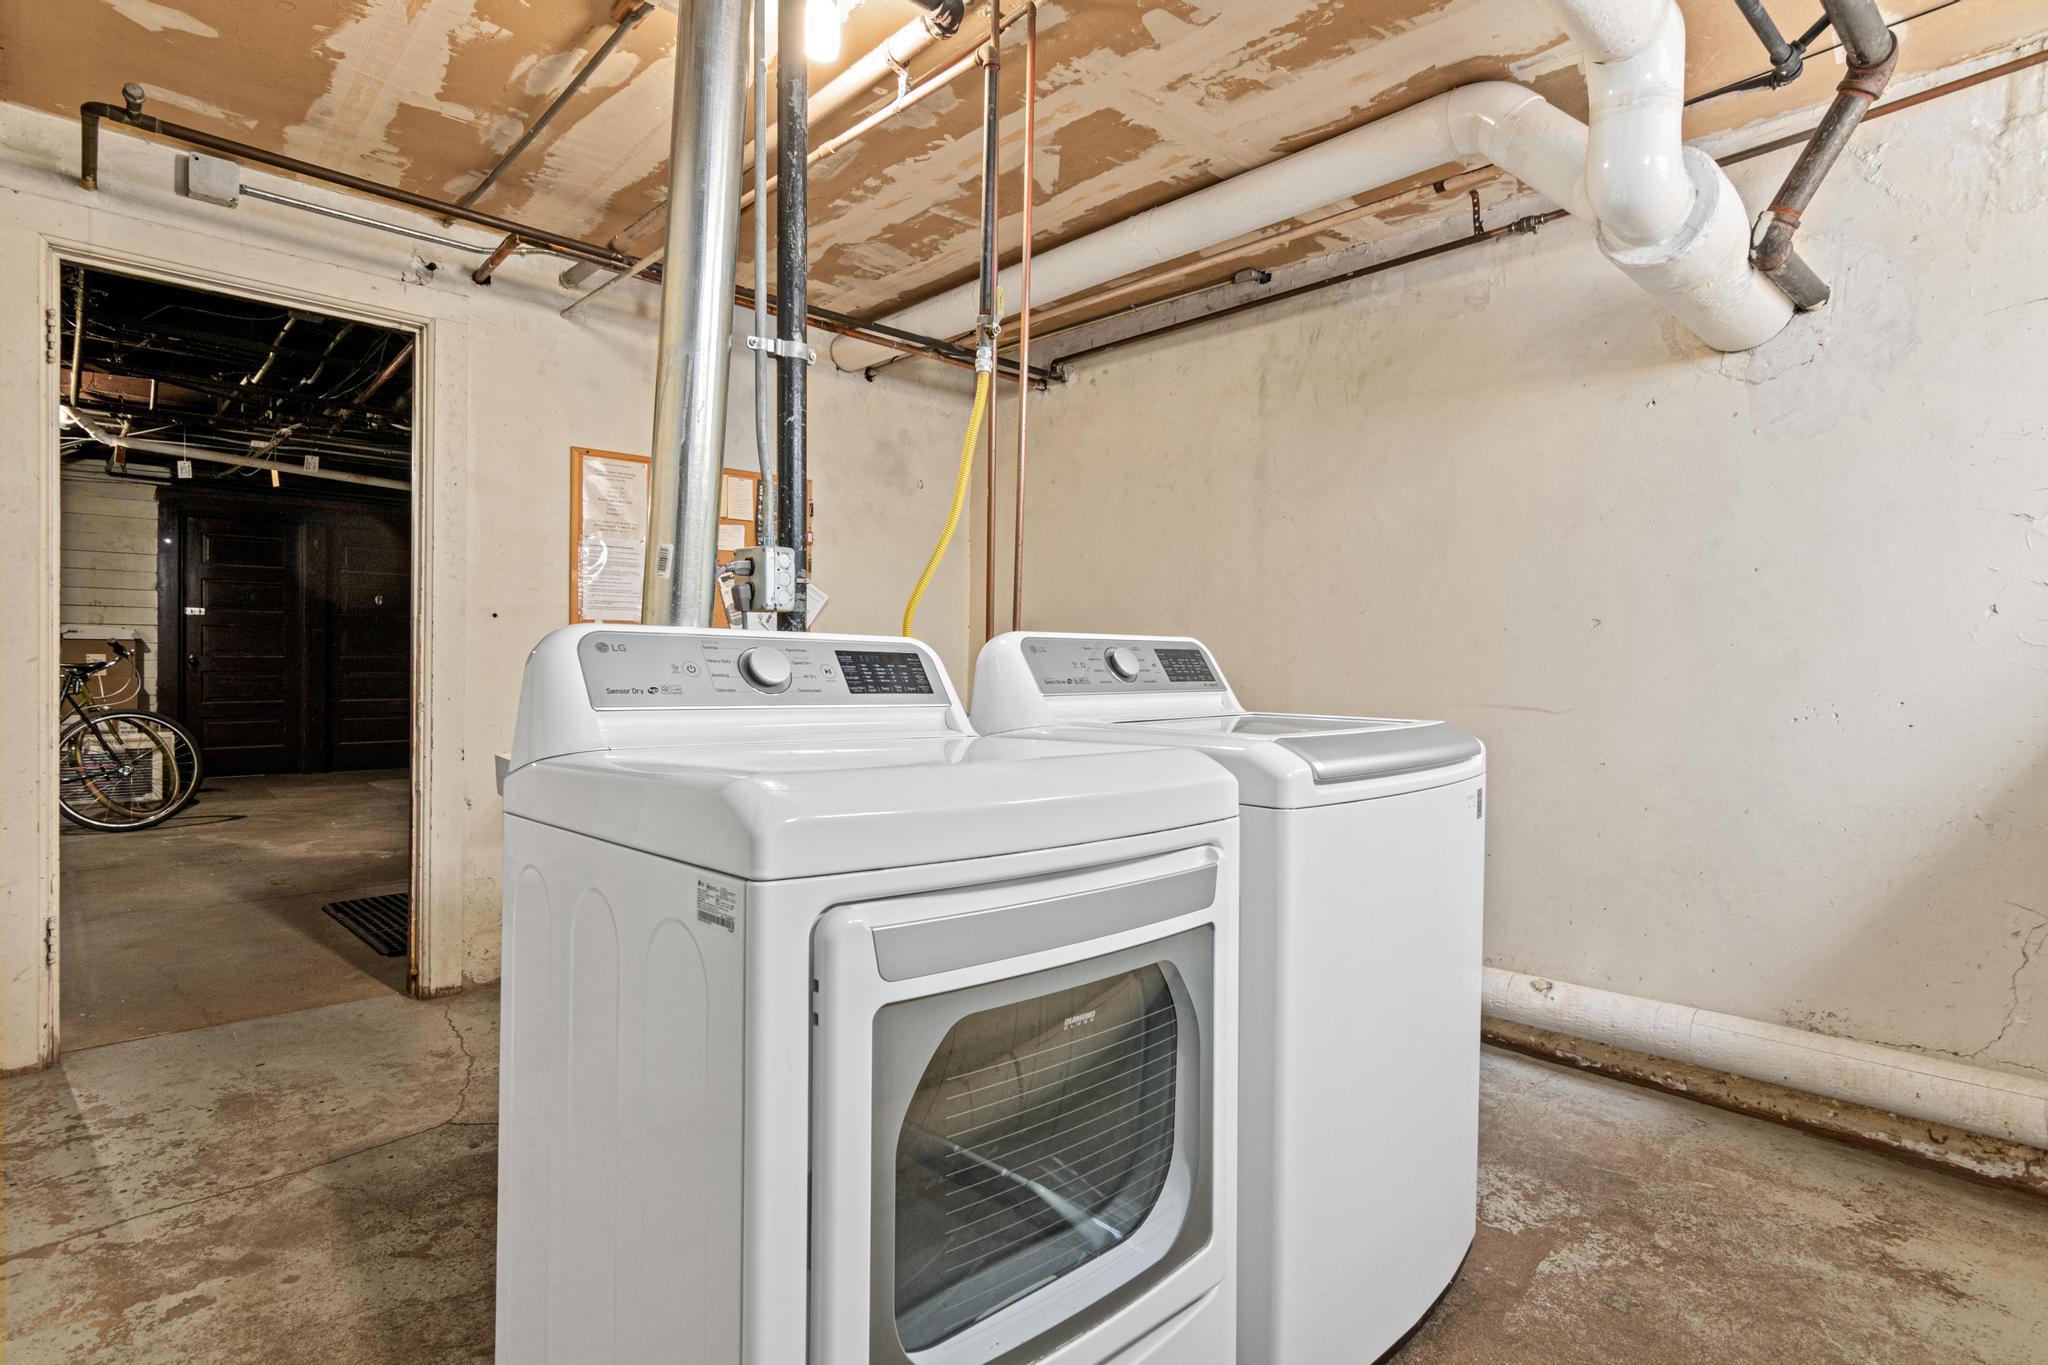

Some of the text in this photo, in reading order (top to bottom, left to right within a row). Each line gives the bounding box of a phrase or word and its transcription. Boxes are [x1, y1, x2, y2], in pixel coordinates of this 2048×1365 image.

[611, 644, 627, 652] LG
[606, 687, 630, 695] Sensor
[631, 687, 644, 696] Dry
